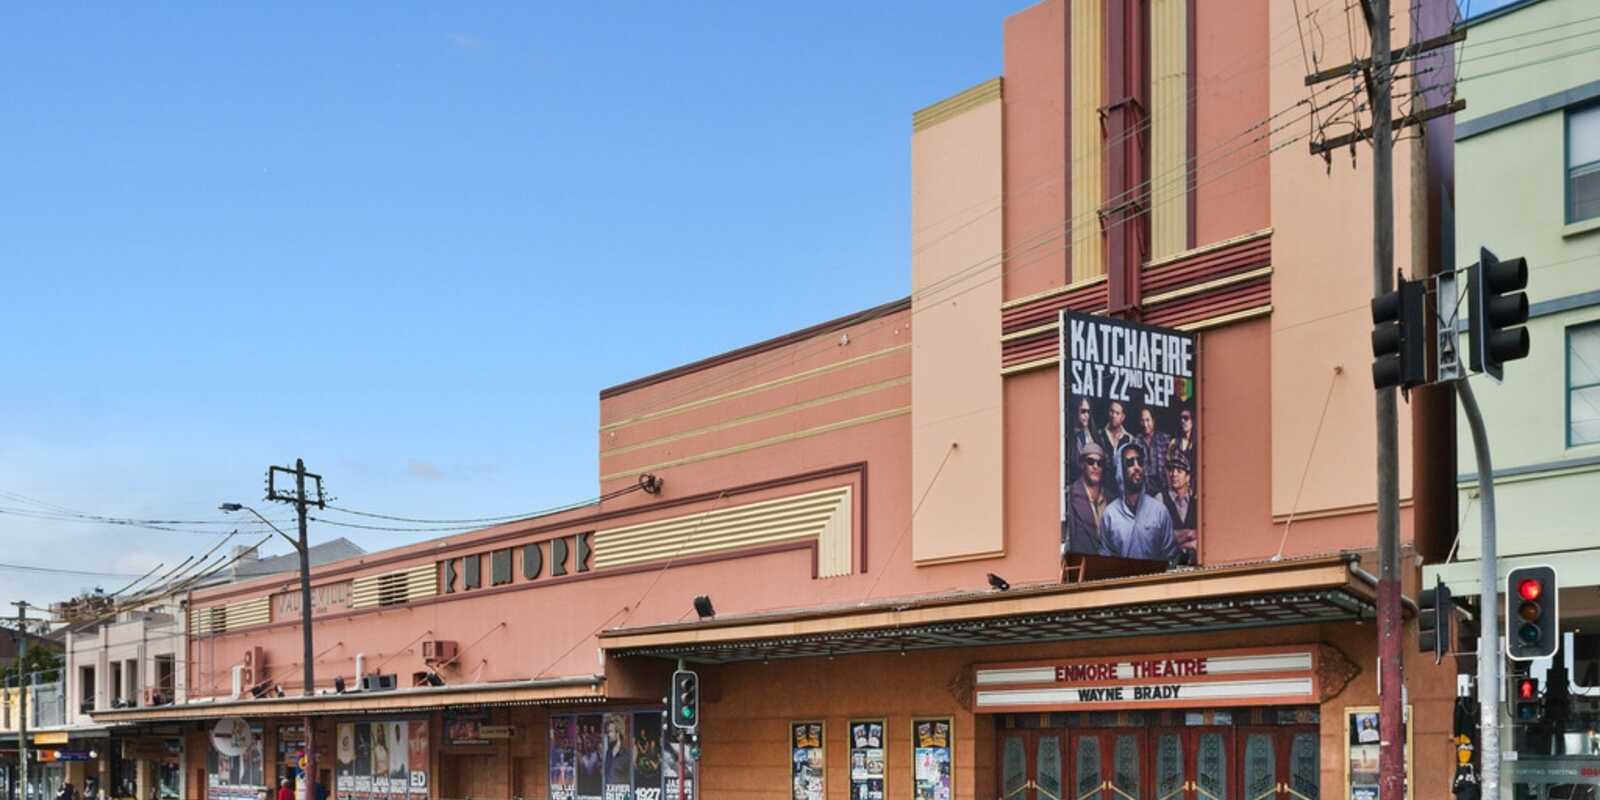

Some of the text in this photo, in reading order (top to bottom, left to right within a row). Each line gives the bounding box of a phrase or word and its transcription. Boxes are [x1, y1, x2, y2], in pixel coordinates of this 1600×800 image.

[1071, 319, 1193, 378] KATCHAFIRE
[1072, 360, 1175, 407] SAT 22ND SEP
[443, 532, 592, 593] ENMORE
[279, 582, 353, 615] VAUEVILLE
[1054, 657, 1208, 682] ENMORE THEATRE
[1078, 685, 1182, 702] WAYNE BRADY
[410, 771, 426, 787] ED
[635, 787, 661, 800] 1927
